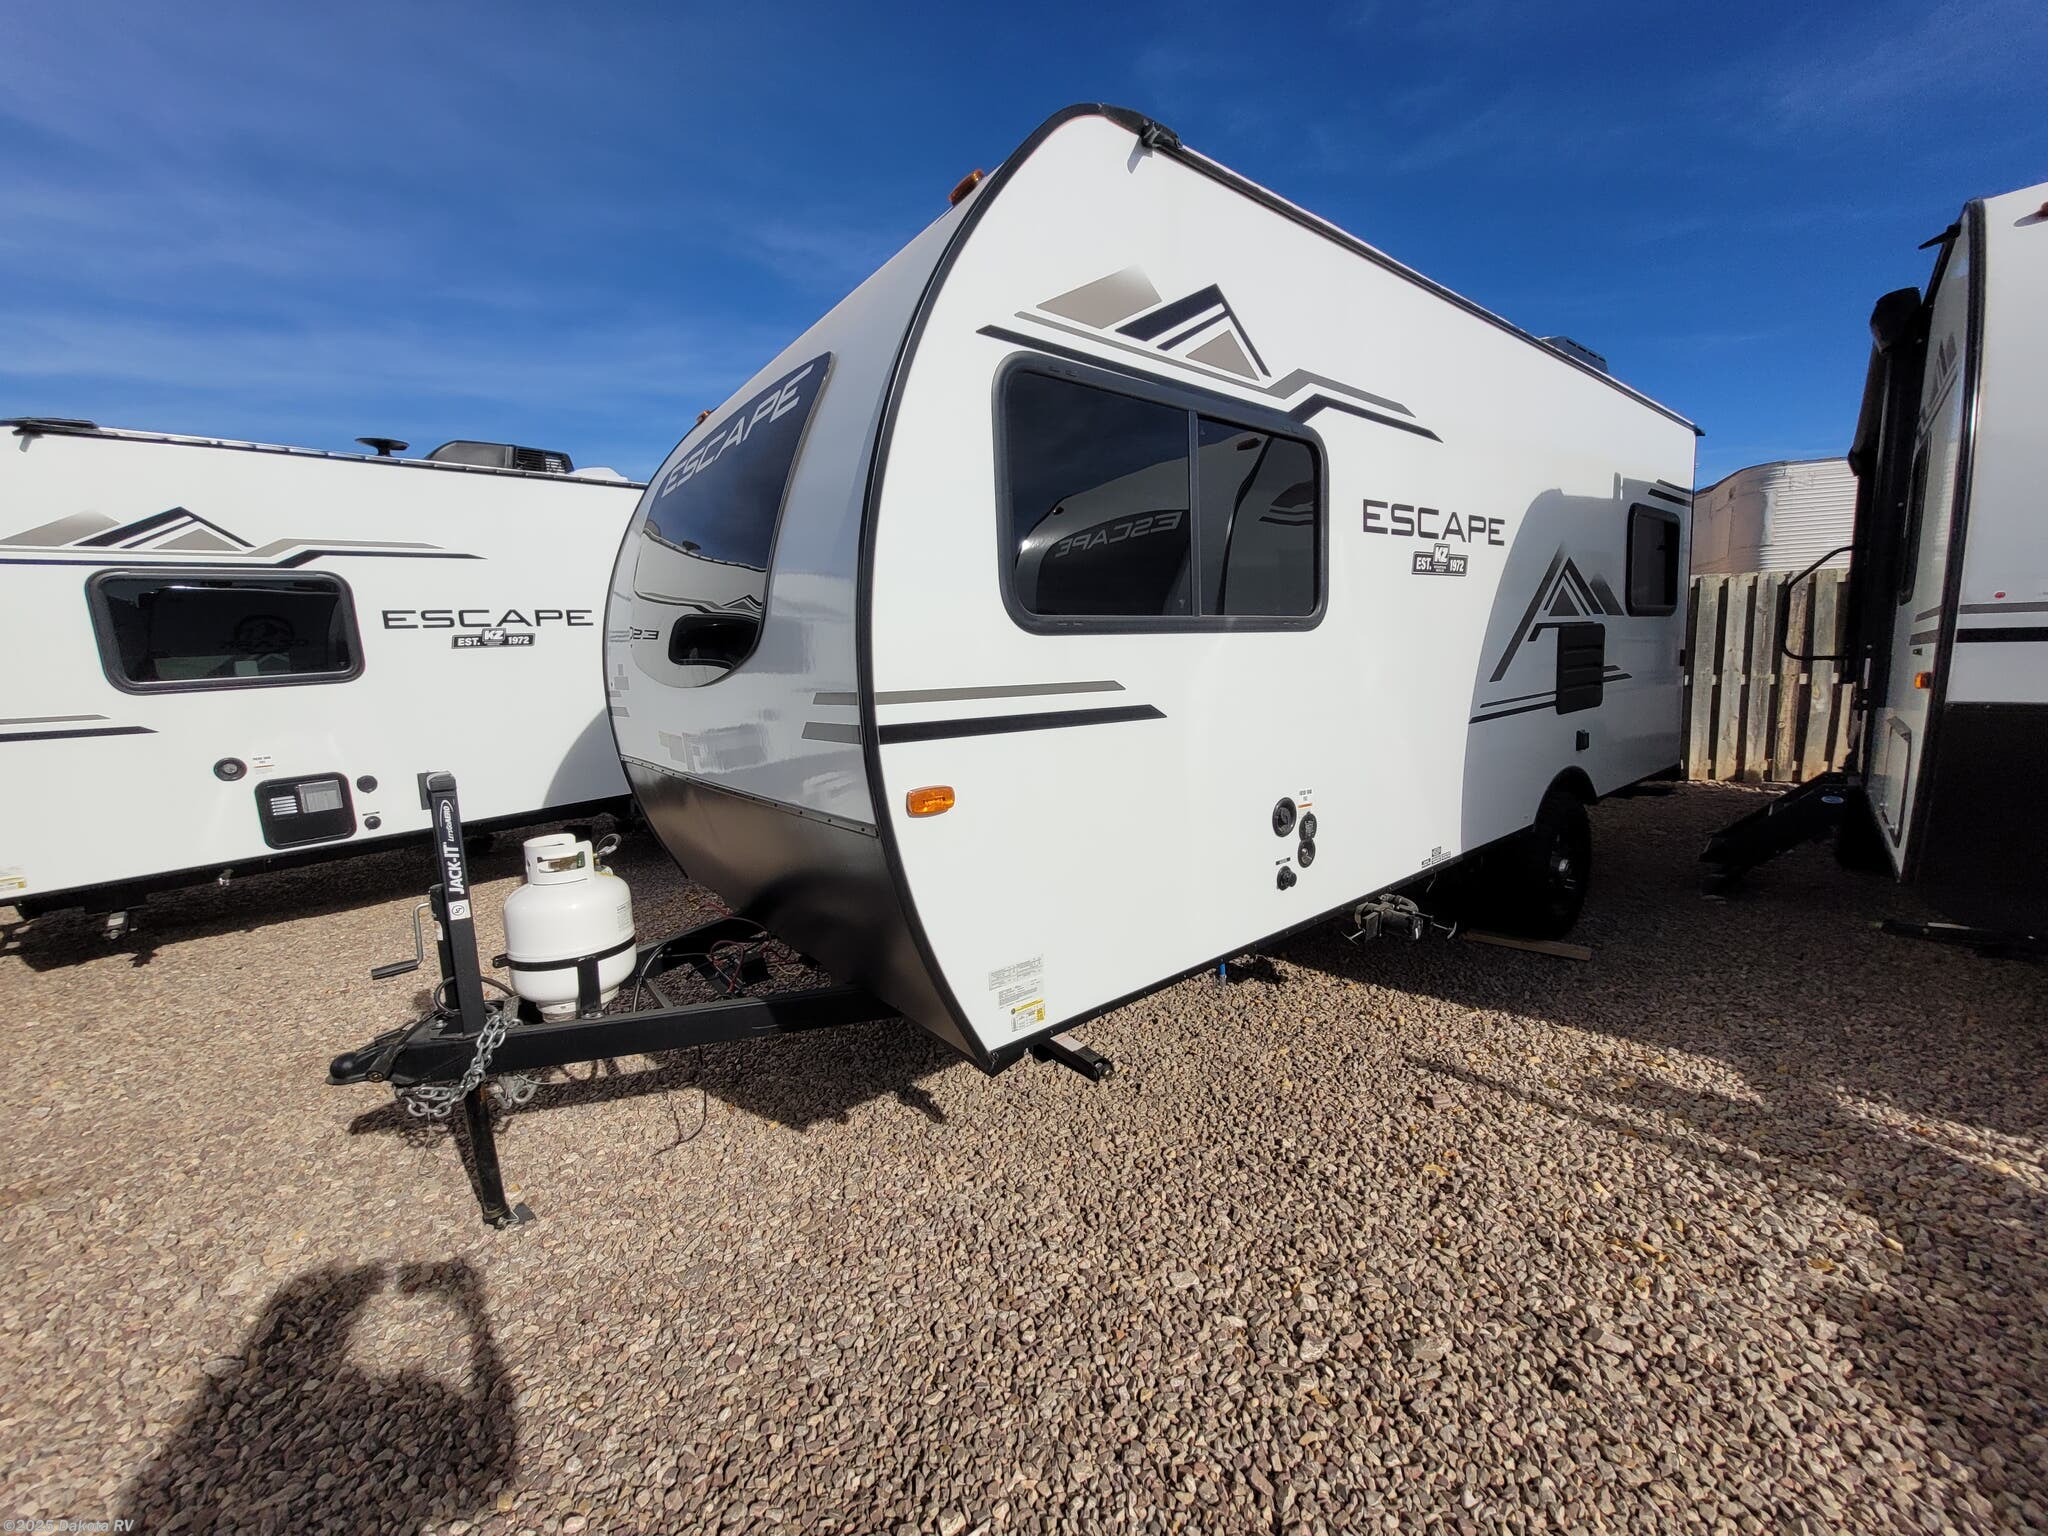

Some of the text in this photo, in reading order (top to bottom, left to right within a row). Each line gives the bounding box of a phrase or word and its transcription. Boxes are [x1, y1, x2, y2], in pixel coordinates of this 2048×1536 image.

[661, 363, 814, 498] ESCAPE
[1362, 498, 1505, 546] ESCAPE
[1434, 546, 1449, 563] KZ
[1415, 556, 1432, 570] EST.
[1449, 559, 1465, 572] 1972
[381, 609, 594, 629] ESCAPE
[457, 636, 530, 646] EST. 1972
[484, 630, 504, 640] KZ
[442, 843, 464, 895] JACK-IT
